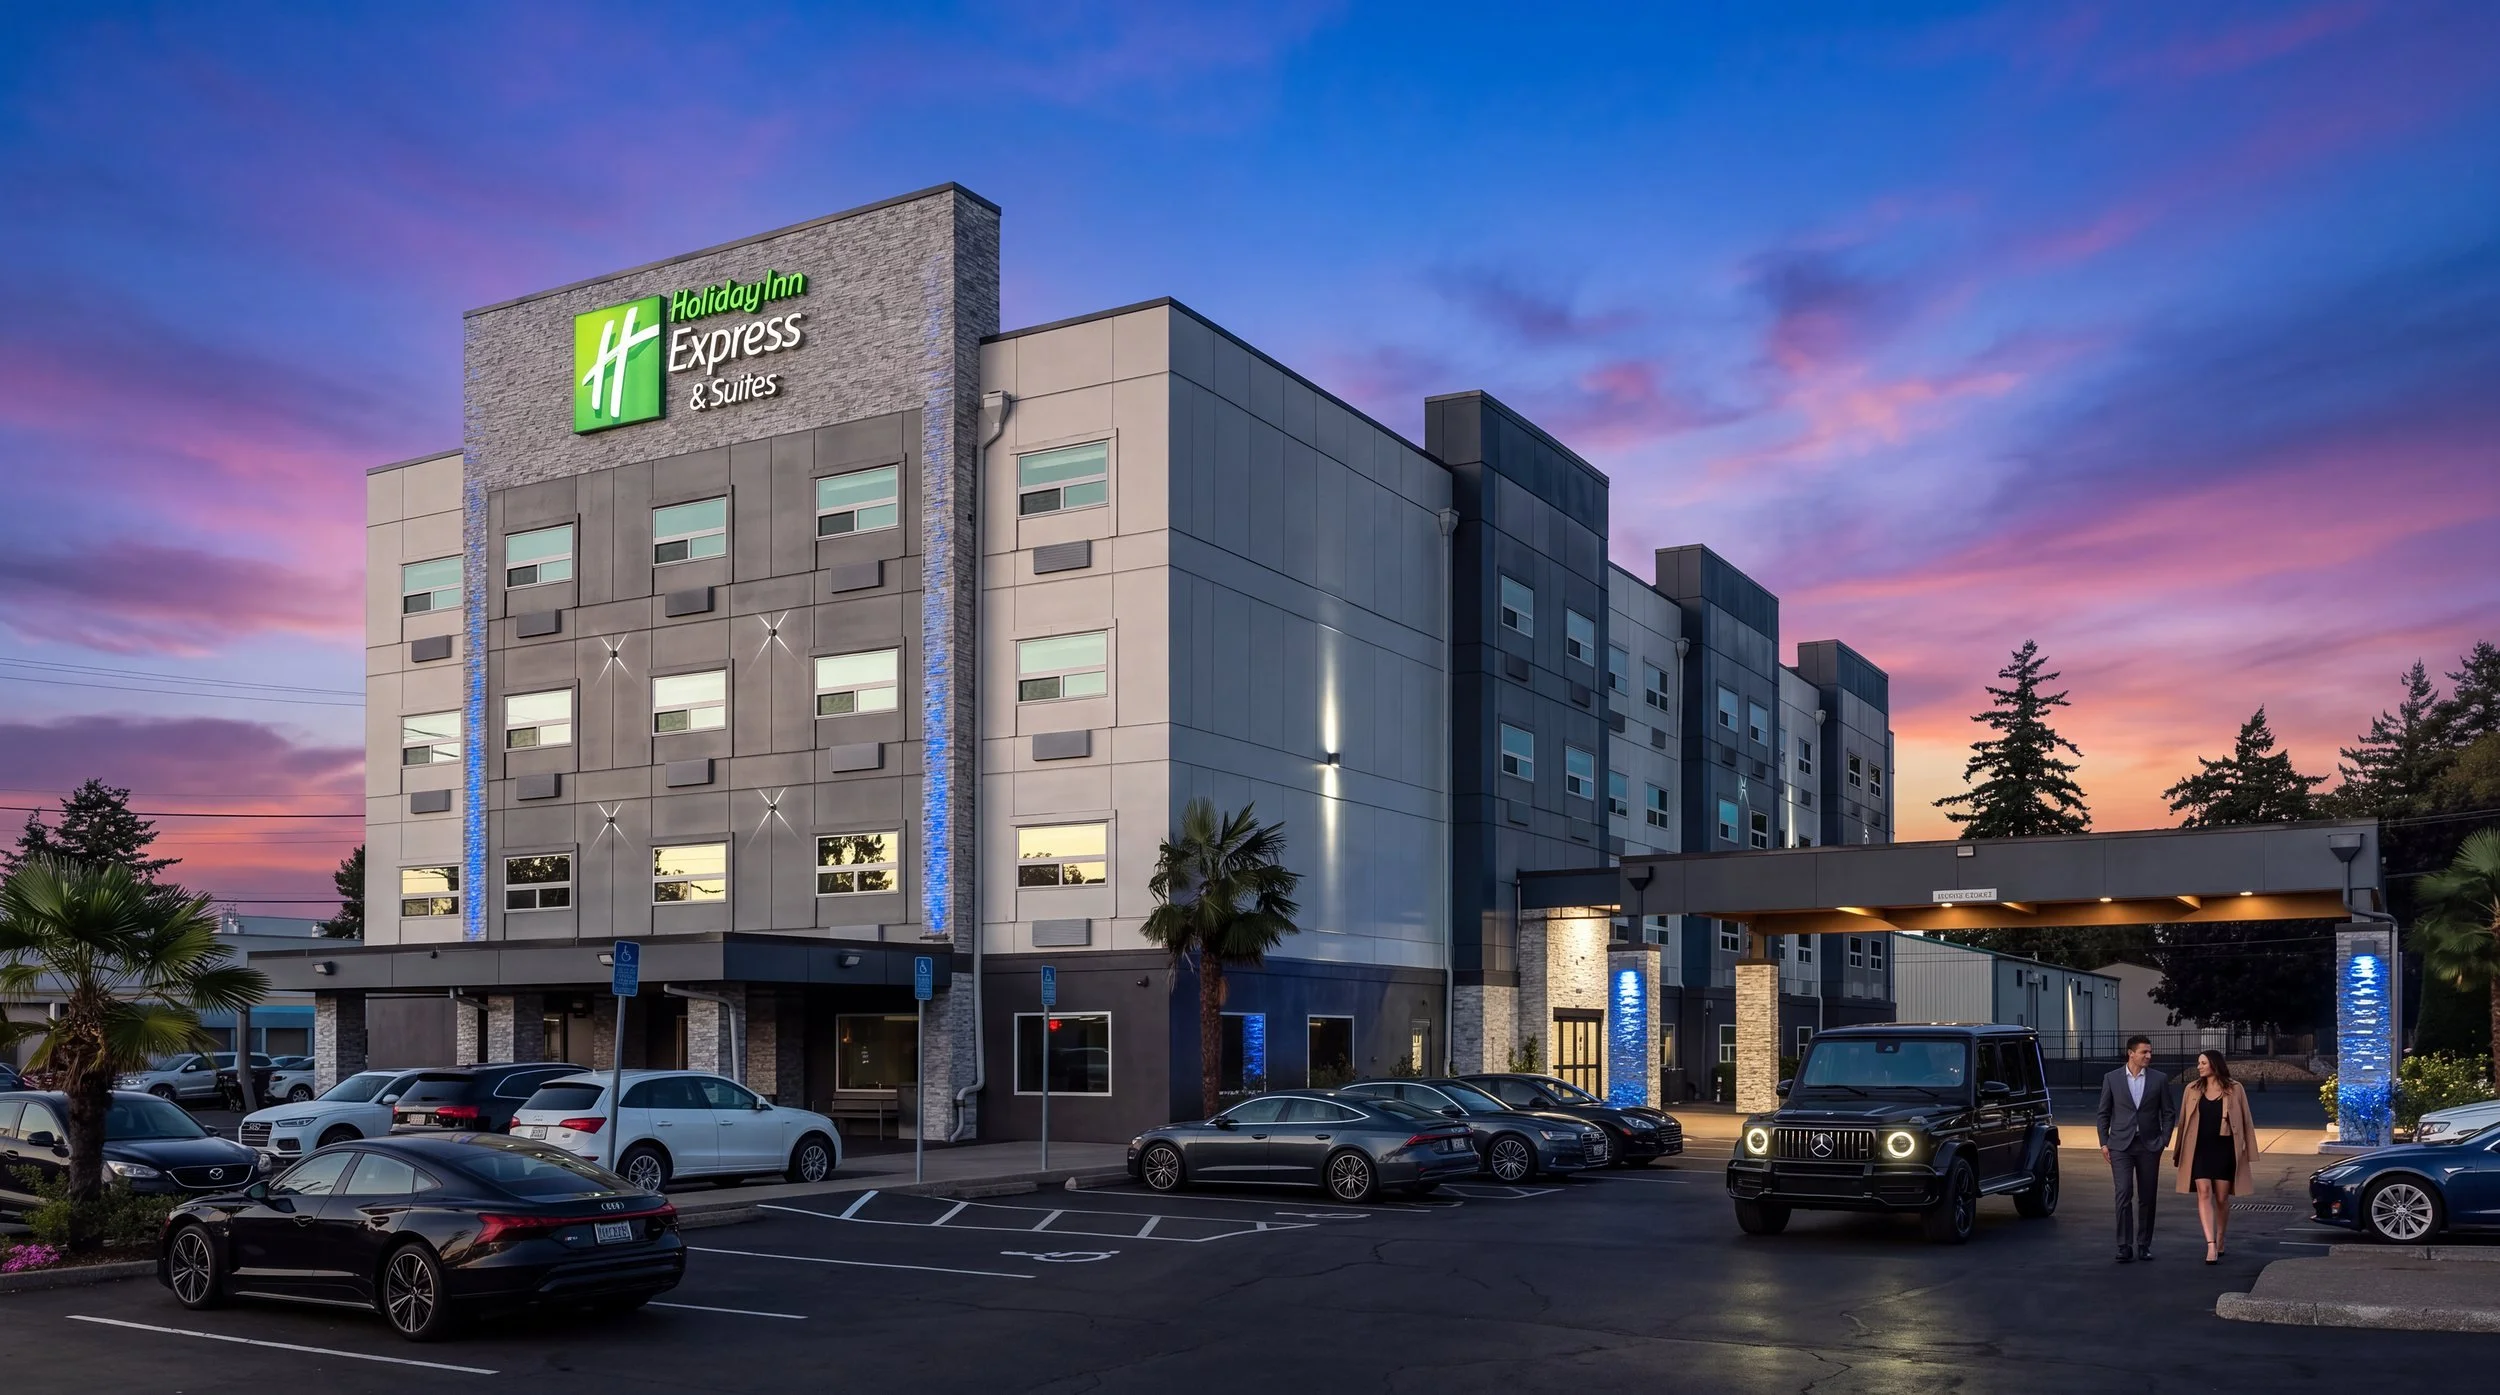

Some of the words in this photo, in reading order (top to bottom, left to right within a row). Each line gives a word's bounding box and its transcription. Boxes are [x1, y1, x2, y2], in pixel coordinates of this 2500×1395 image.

[668, 312, 803, 376] Express
[689, 382, 707, 411] &
[709, 373, 778, 408] Suites
